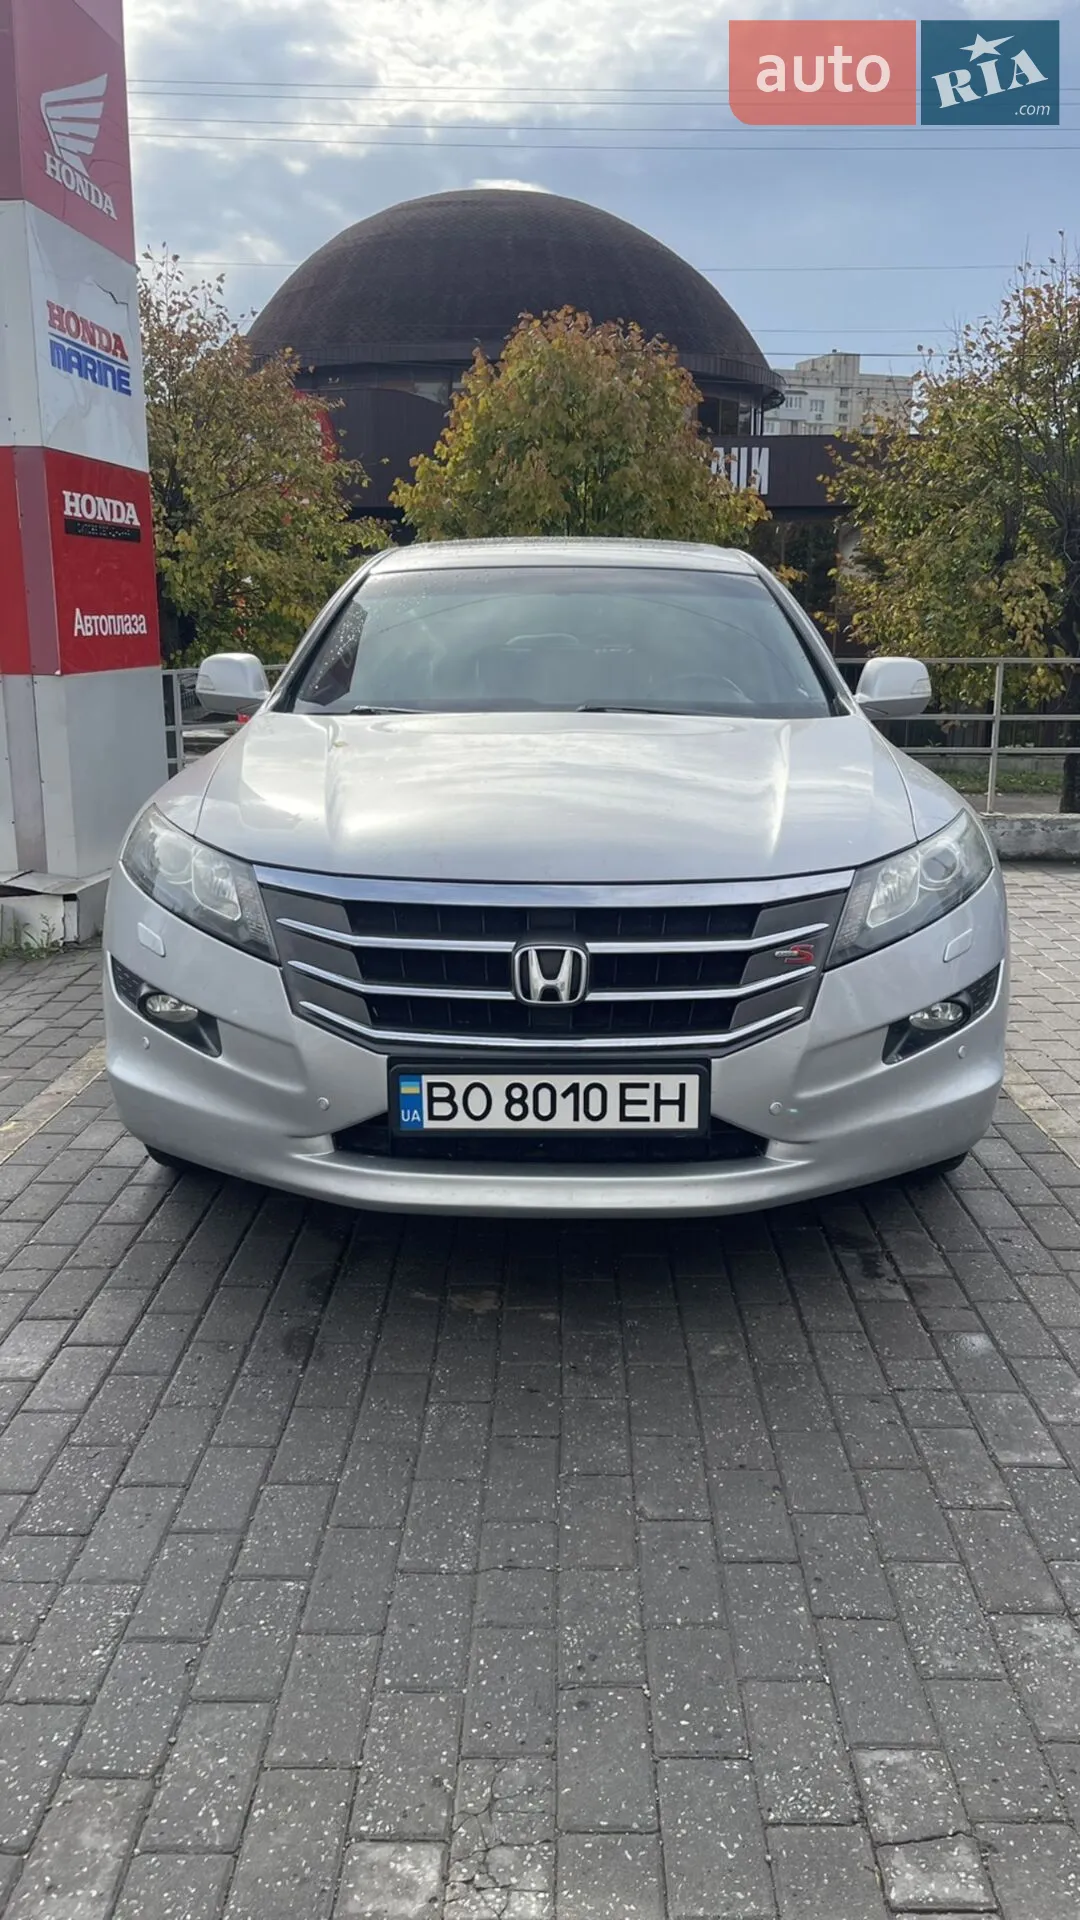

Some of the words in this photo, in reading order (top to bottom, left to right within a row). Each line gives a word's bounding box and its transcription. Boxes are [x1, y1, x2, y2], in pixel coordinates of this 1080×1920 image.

[44, 150, 118, 221] HONDA
[46, 299, 129, 362] HONDA
[50, 339, 132, 397] MARINE
[62, 490, 141, 526] HONDA
[74, 607, 148, 637] Автоплаза
[401, 1110, 421, 1123] UA
[426, 1081, 493, 1122] BO
[504, 1081, 608, 1122] 8010
[619, 1082, 686, 1122] EH
